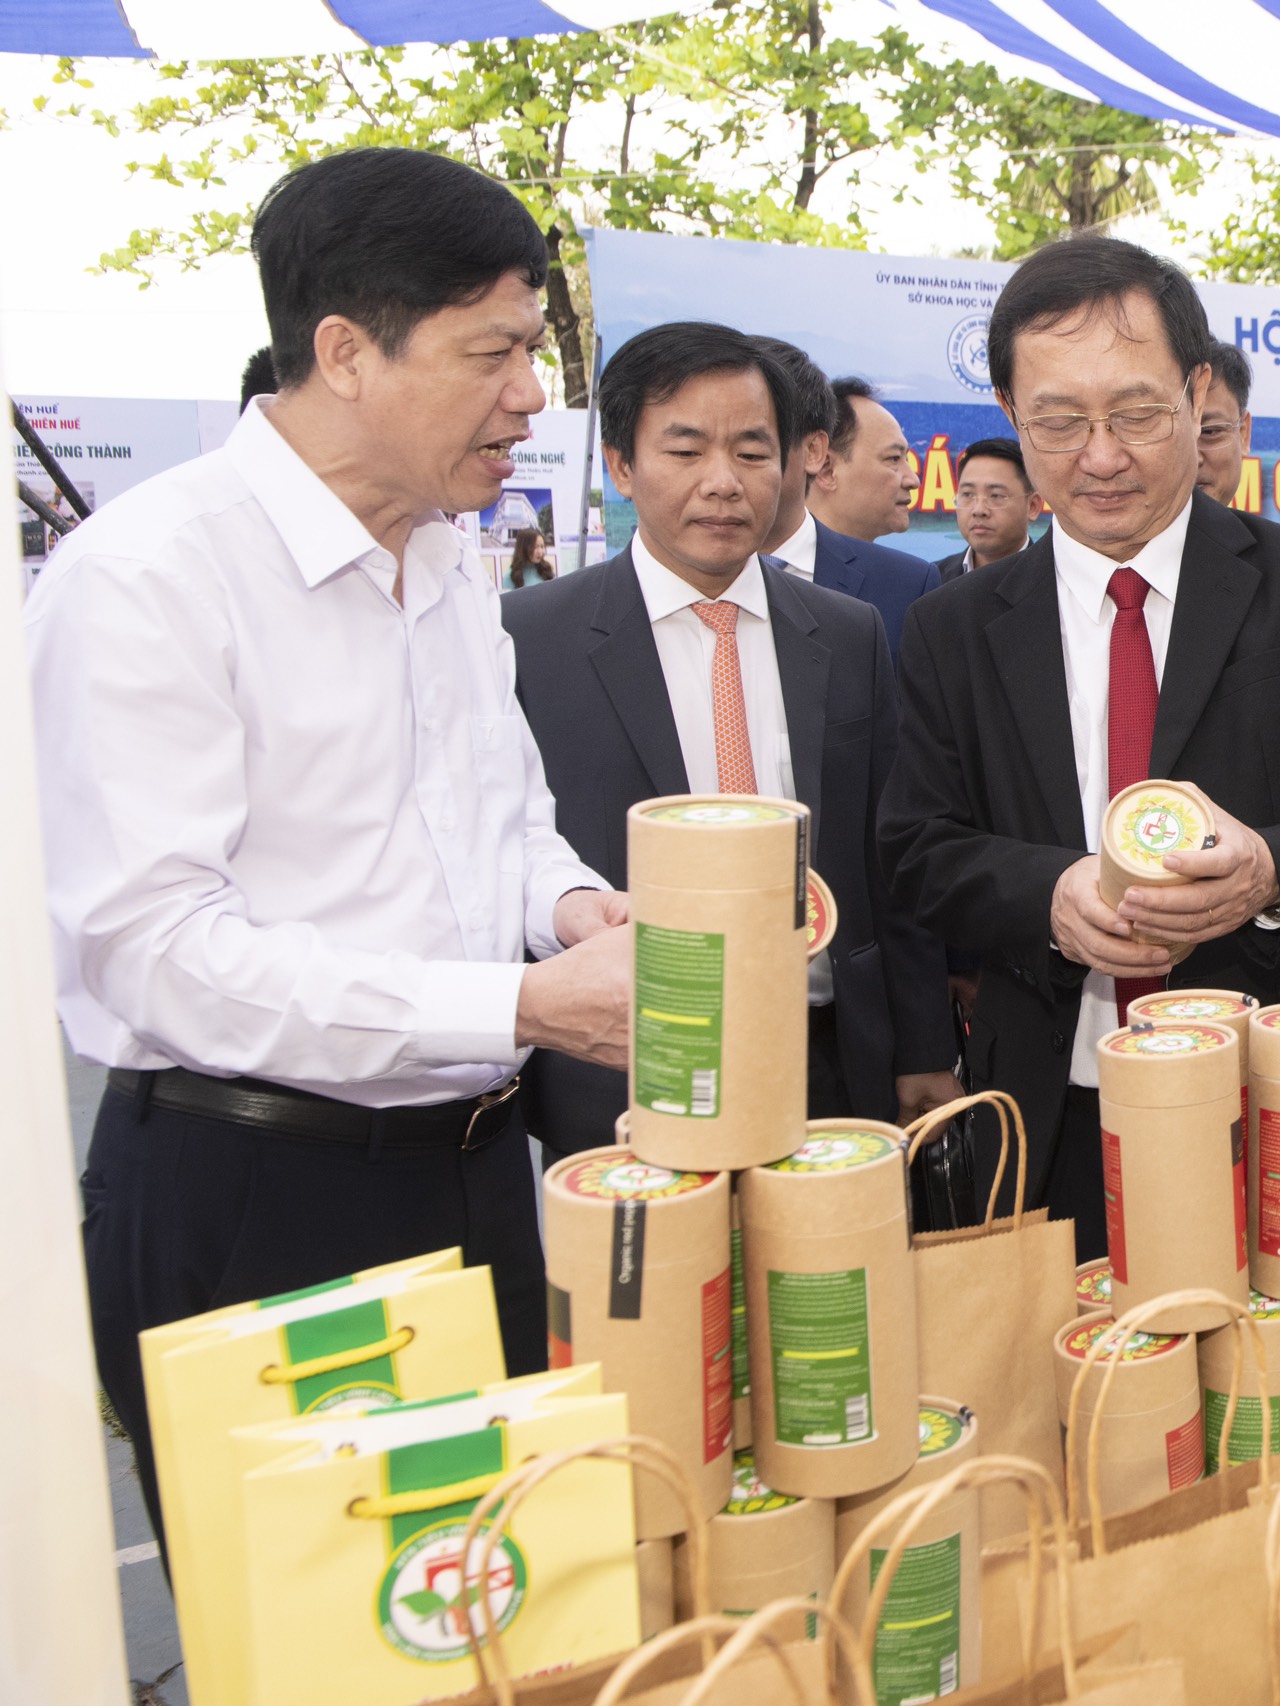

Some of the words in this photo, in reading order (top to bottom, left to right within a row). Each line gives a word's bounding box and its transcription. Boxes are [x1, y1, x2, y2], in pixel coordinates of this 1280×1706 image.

[894, 275, 915, 286] BAN
[918, 276, 948, 289] NHÂN
[951, 279, 971, 291] DÂN
[925, 295, 954, 306] KHOA
[956, 298, 977, 309] HỌC
[980, 299, 993, 308] VÀ
[37, 403, 59, 414] HUẾ
[27, 417, 57, 429] HIÊN
[60, 417, 81, 430] HUẾ
[87, 443, 132, 459] THÀNH
[541, 450, 566, 466] NGHỆ
[618, 1244, 635, 1284] Organic
